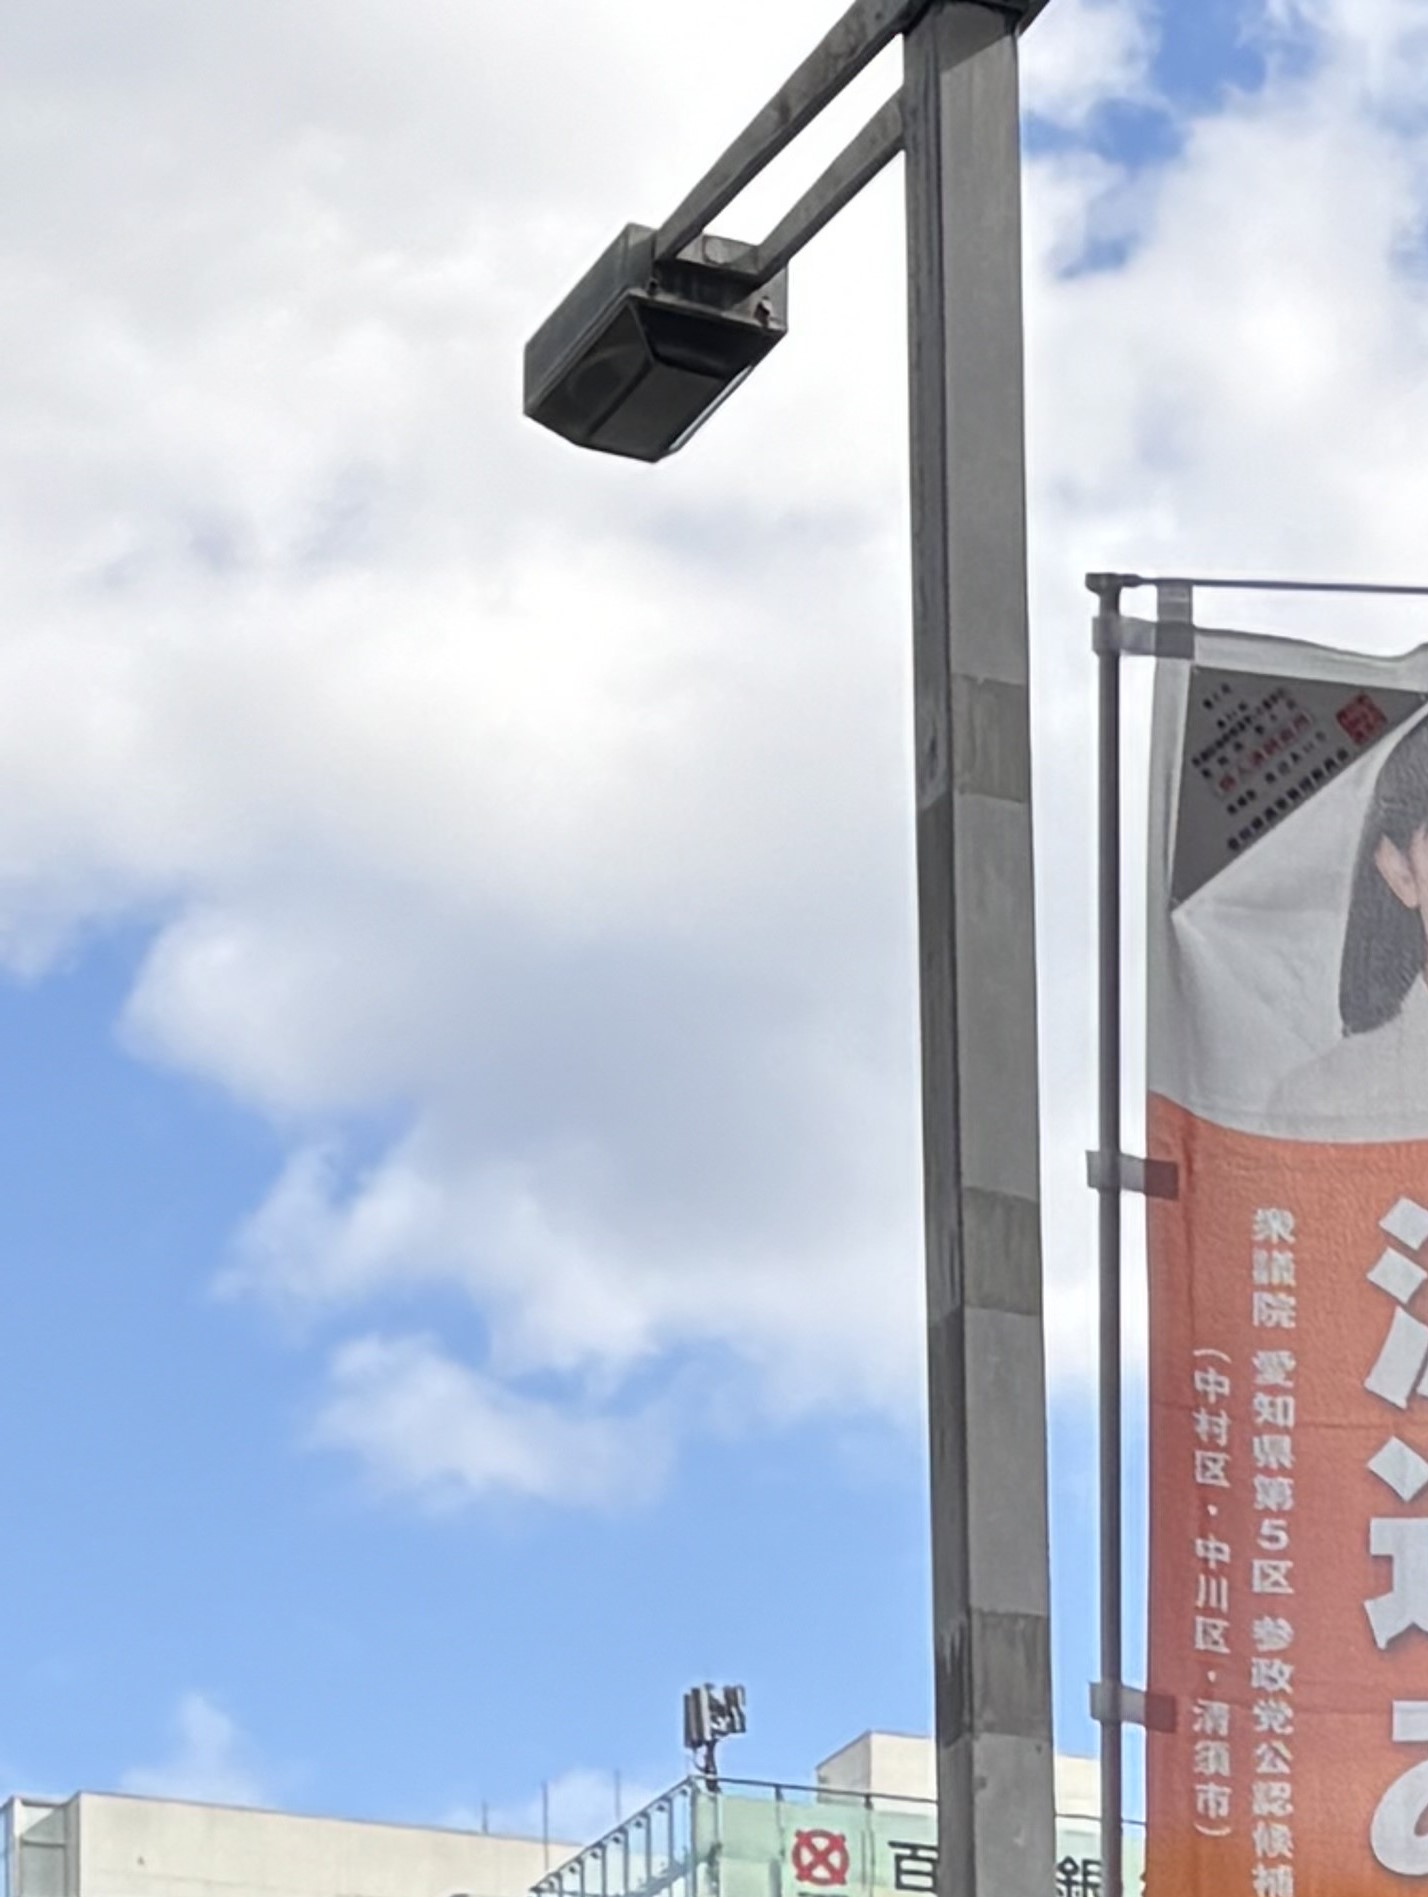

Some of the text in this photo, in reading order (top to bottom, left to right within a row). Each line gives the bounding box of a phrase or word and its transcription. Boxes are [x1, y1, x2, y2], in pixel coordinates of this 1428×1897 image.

[1251, 1208, 1296, 1329] 衆議院
[1192, 1347, 1232, 1840] （中村区・中川区・清須市）
[1251, 1349, 1296, 1595] 愛知県第5区
